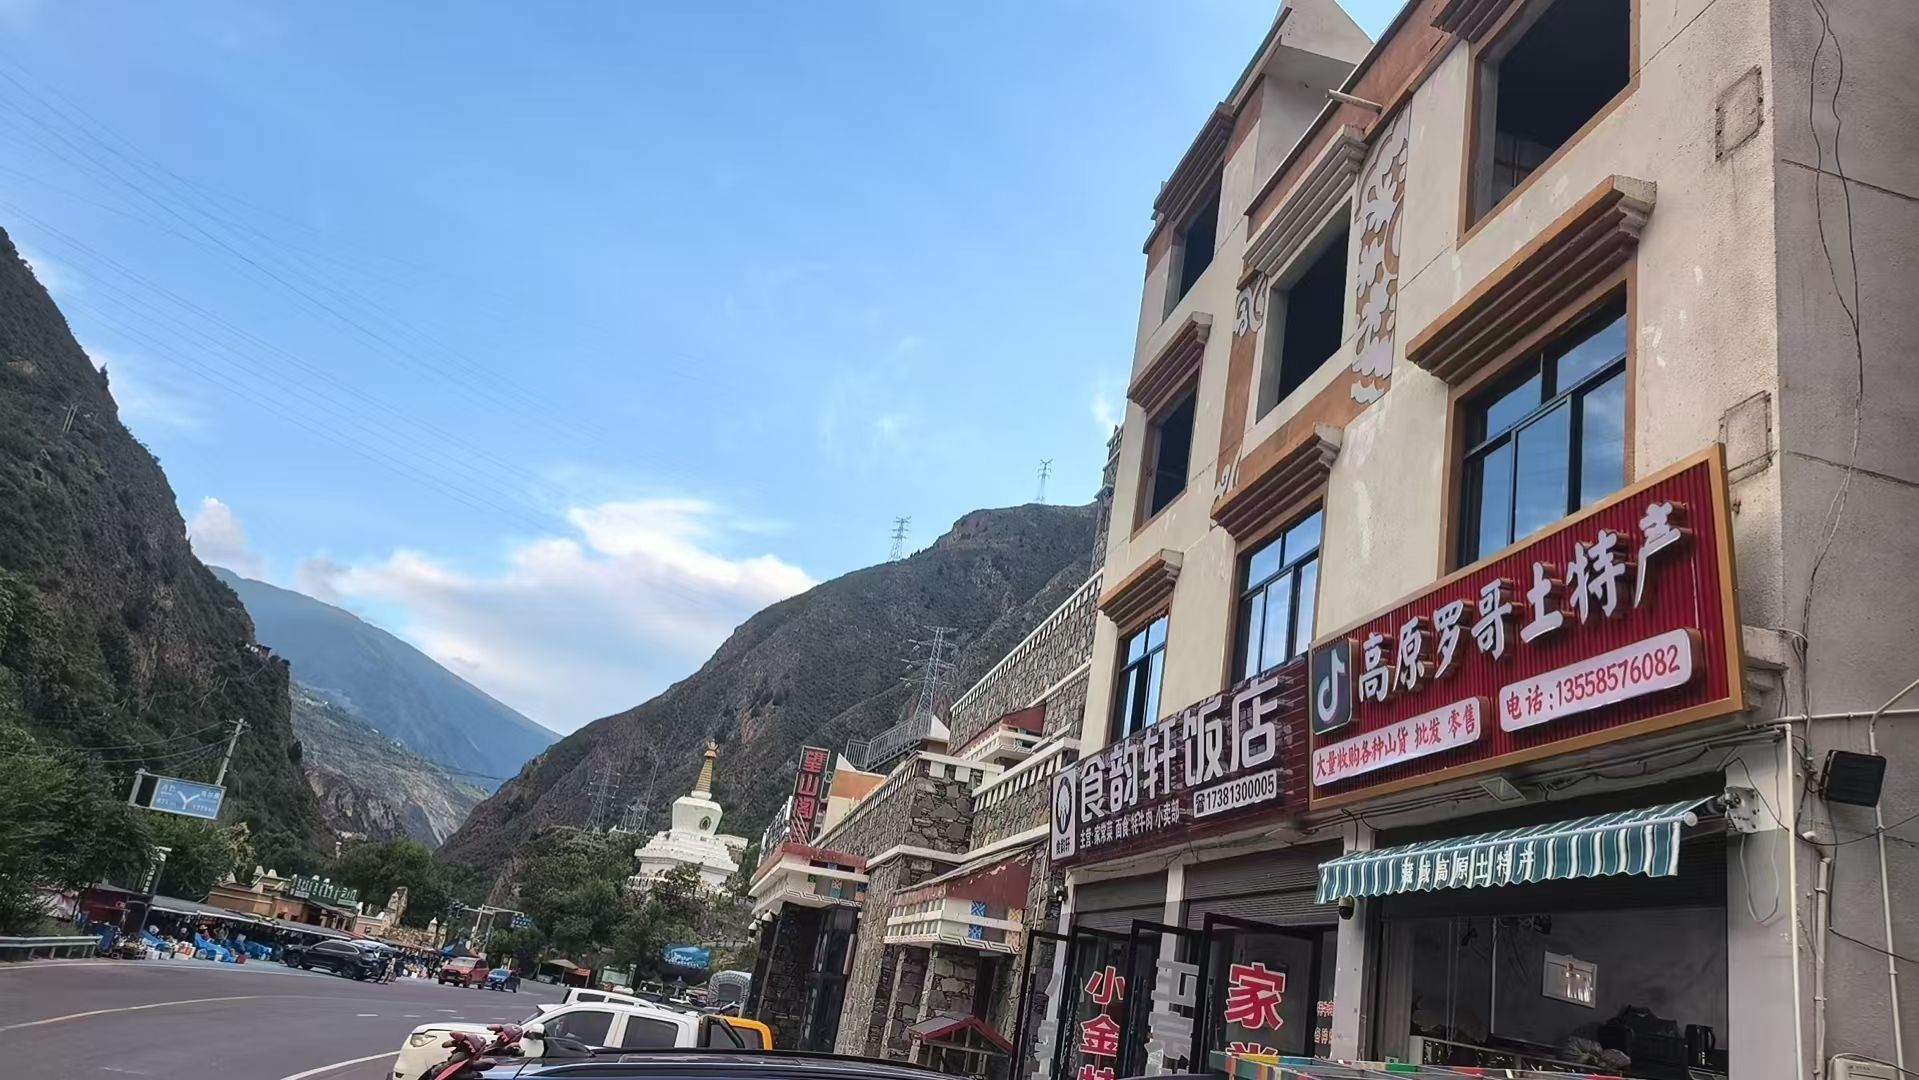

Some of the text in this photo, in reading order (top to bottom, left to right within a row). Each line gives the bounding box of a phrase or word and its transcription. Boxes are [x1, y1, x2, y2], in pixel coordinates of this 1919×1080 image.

[1359, 501, 1681, 702] 高原罗哥土特产
[1081, 677, 1279, 823] 食韵轩饭店
[1316, 704, 1475, 779] 大量收购各种山货 批发 零售
[1156, 798, 1180, 828] 小卖部
[1205, 775, 1275, 811] 17381300005
